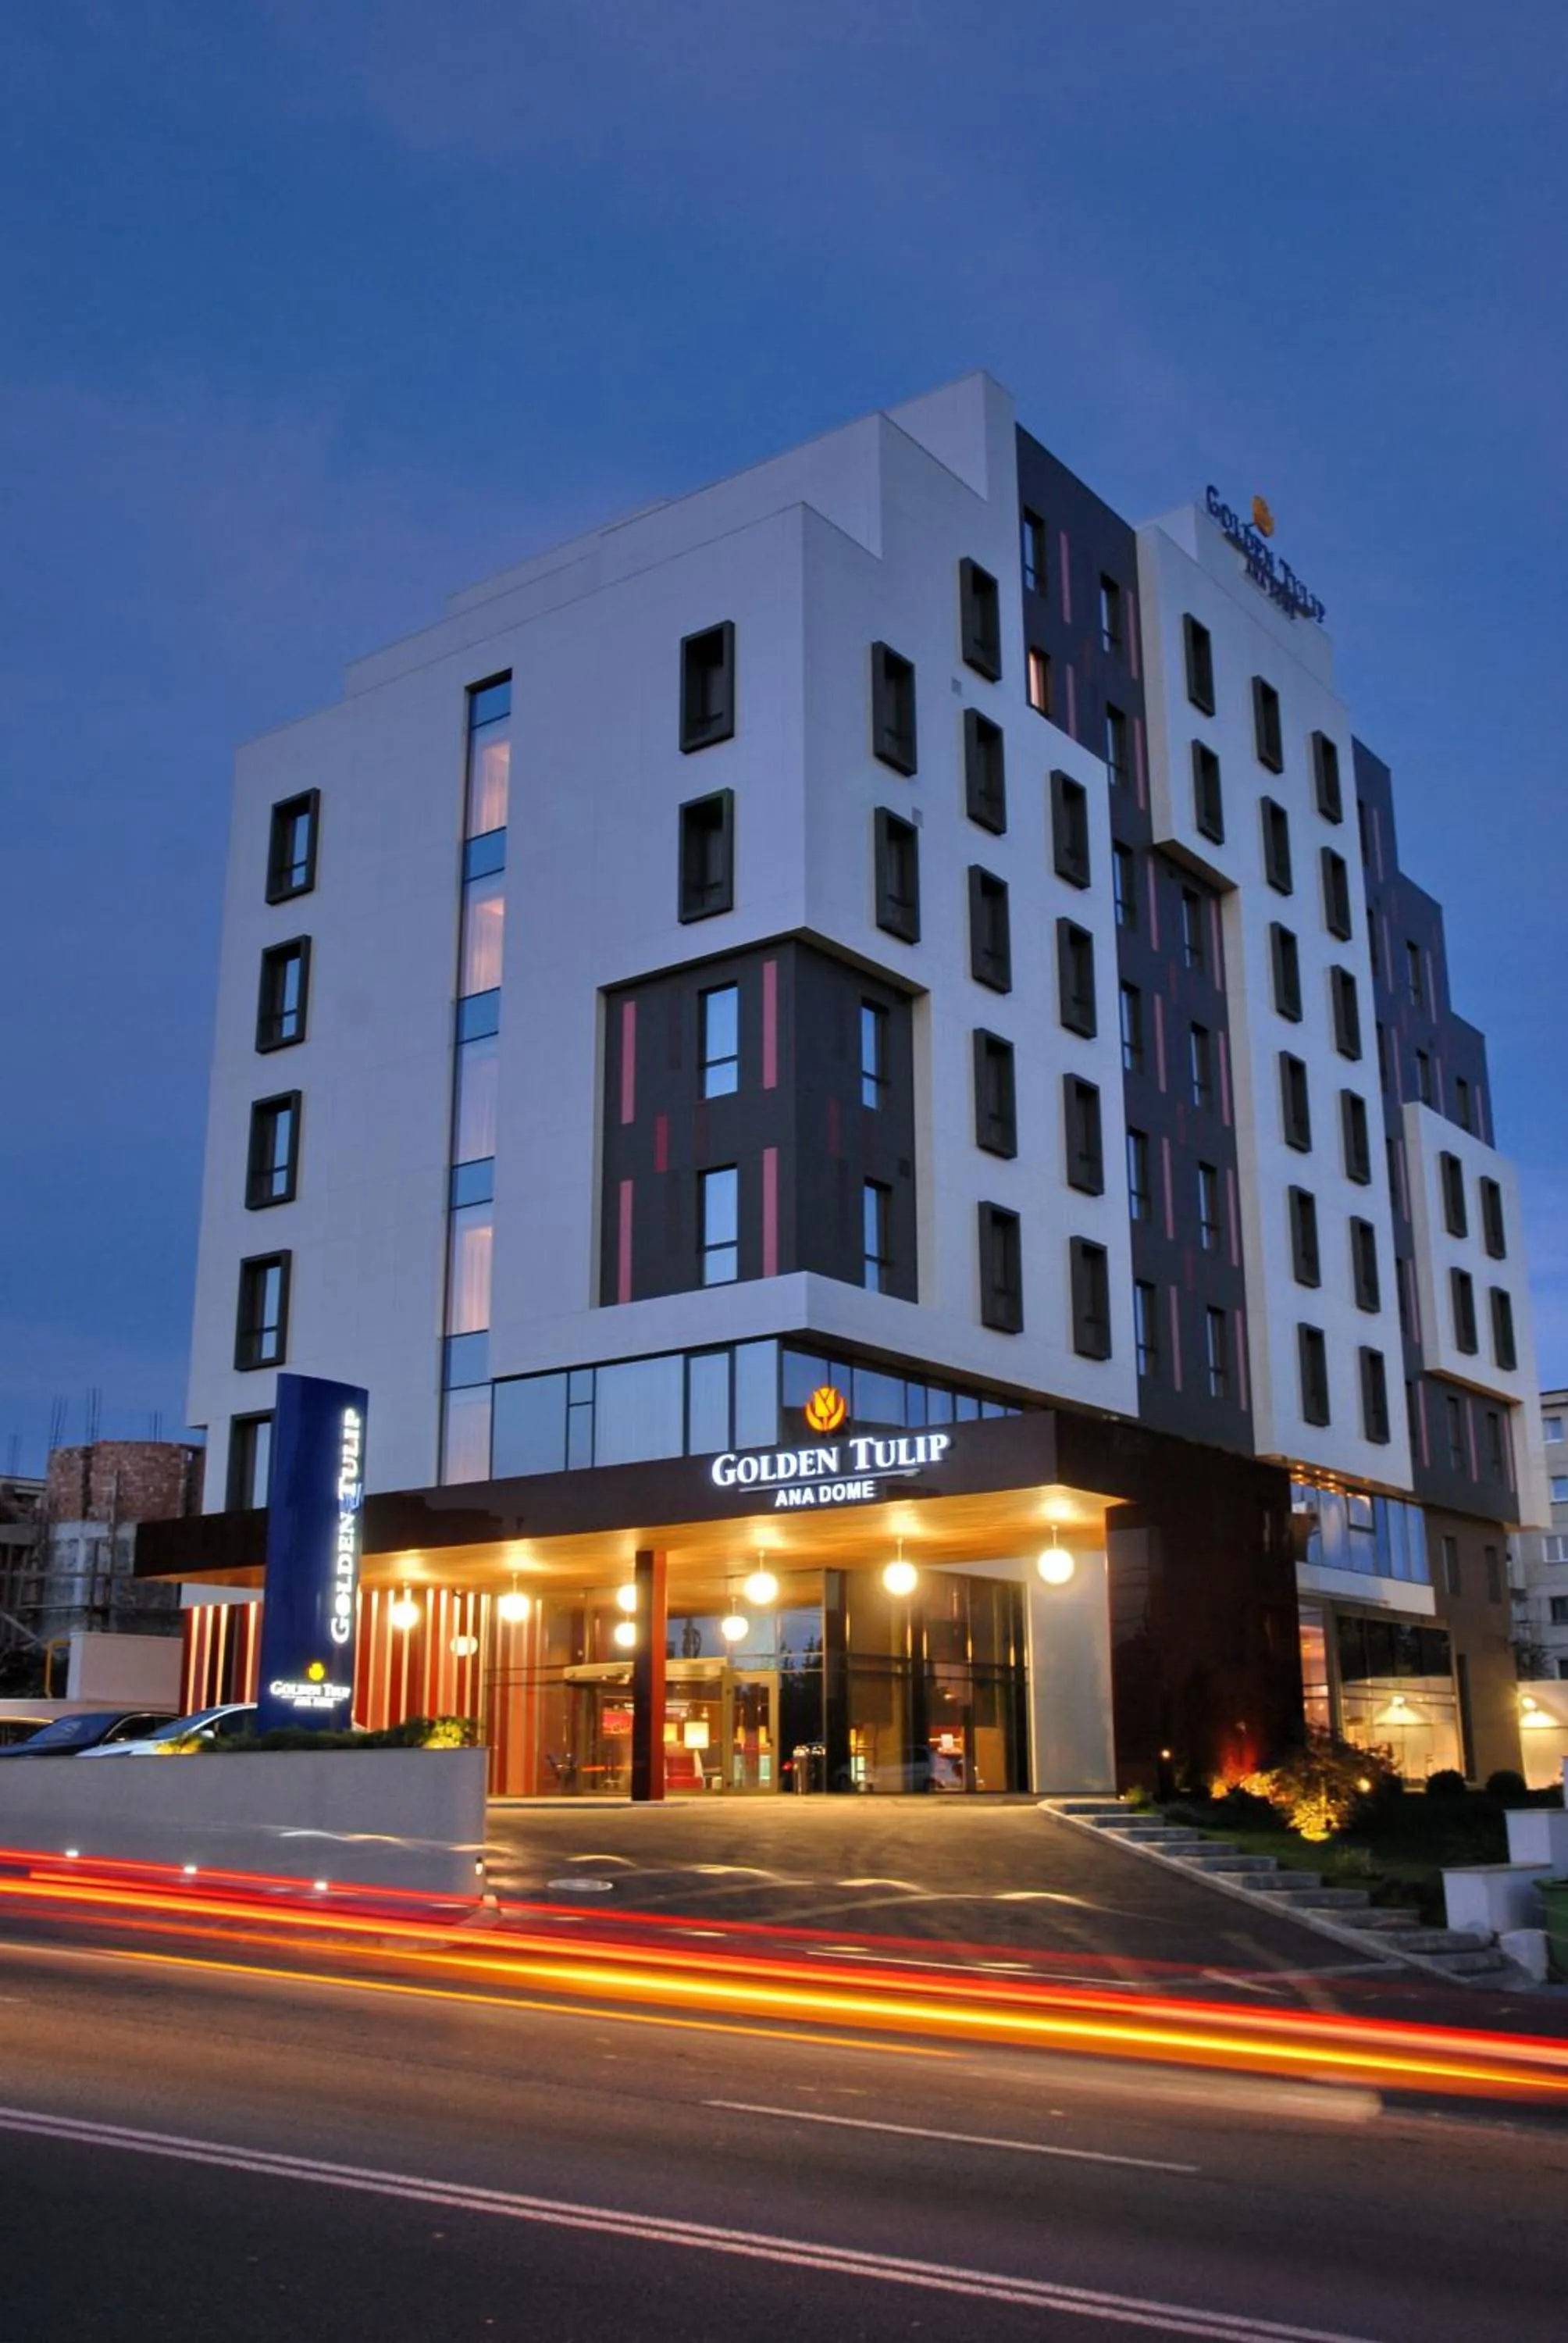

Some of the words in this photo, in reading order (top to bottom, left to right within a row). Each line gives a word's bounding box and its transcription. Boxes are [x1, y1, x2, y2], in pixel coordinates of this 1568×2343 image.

[338, 1408, 360, 1500] TULIP
[711, 1448, 839, 1486] GOLDEN
[850, 1434, 951, 1470] TULIP
[775, 1486, 814, 1507] ANA
[819, 1481, 874, 1503] DOME
[331, 1511, 355, 1644] GOLDEN
